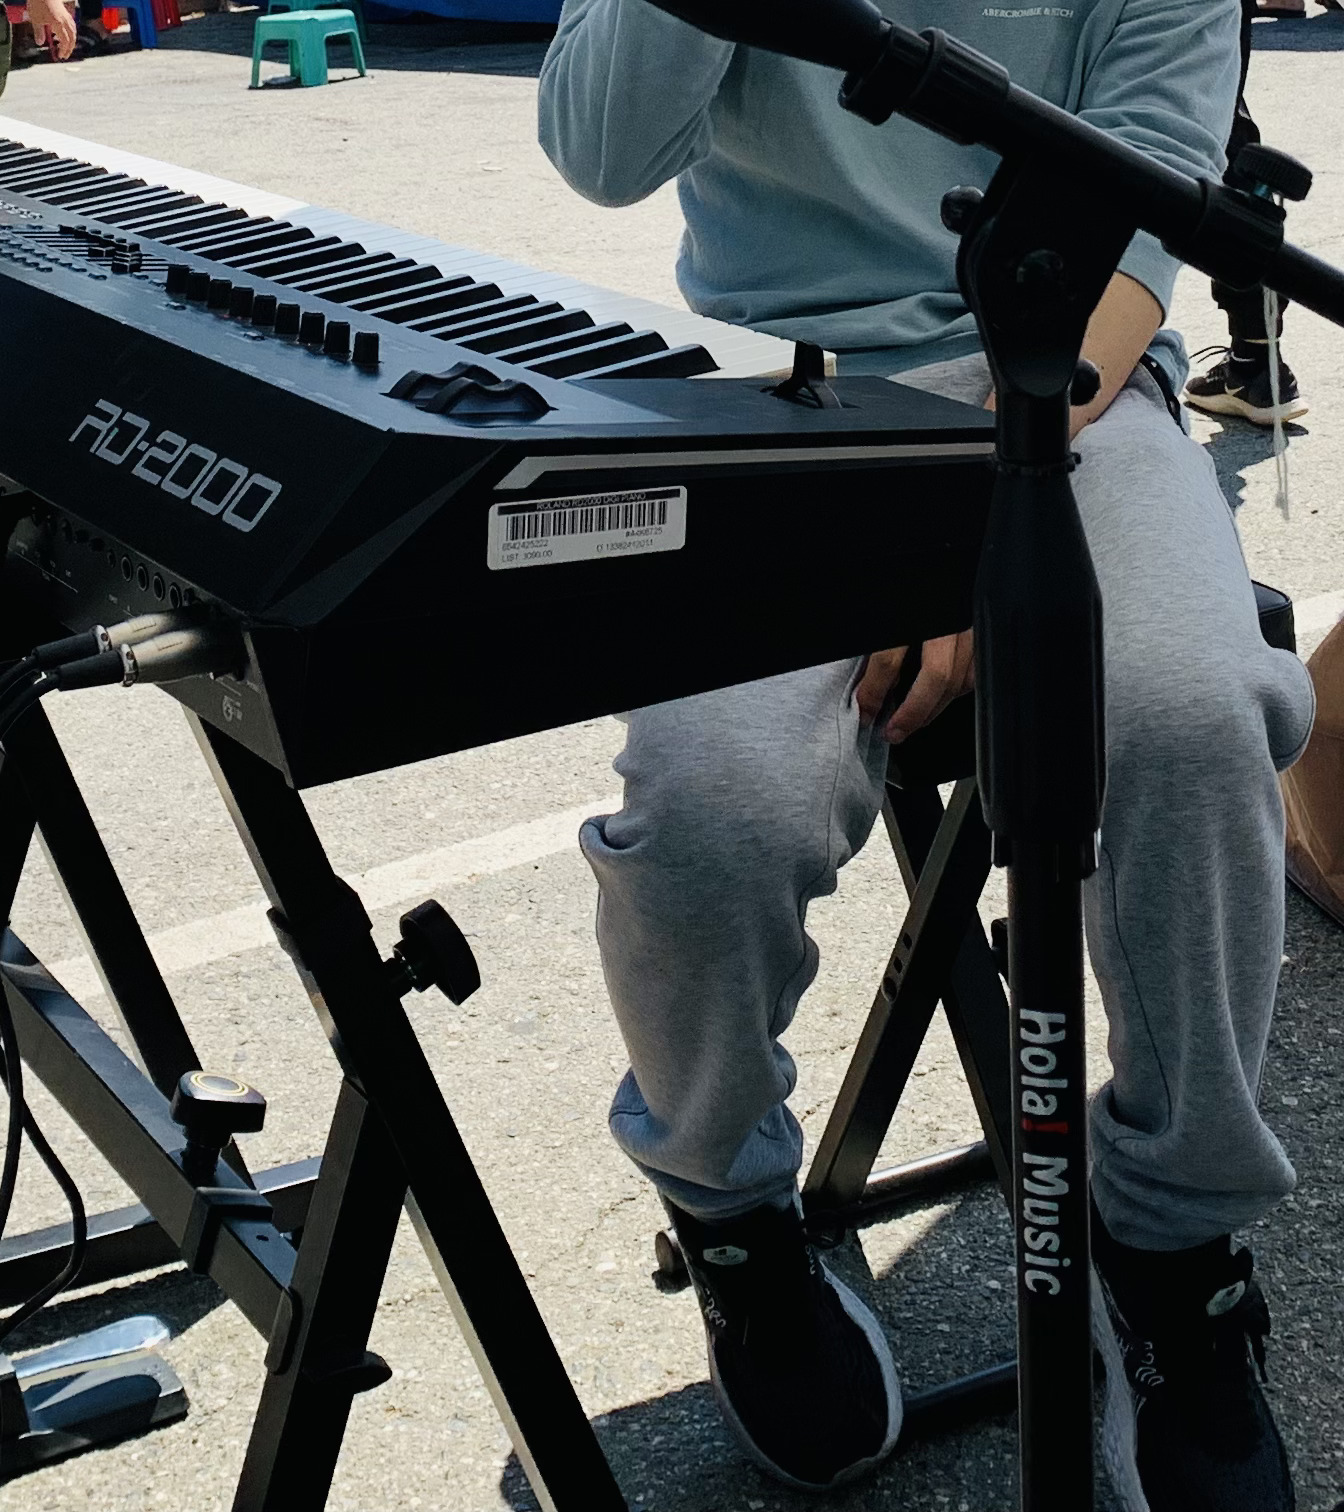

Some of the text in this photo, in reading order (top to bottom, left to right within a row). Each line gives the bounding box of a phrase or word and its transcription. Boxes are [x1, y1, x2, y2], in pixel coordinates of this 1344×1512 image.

[68, 398, 283, 533] RD-2000
[1020, 1008, 1069, 1134] Hola!
[1022, 1152, 1072, 1296] Music
